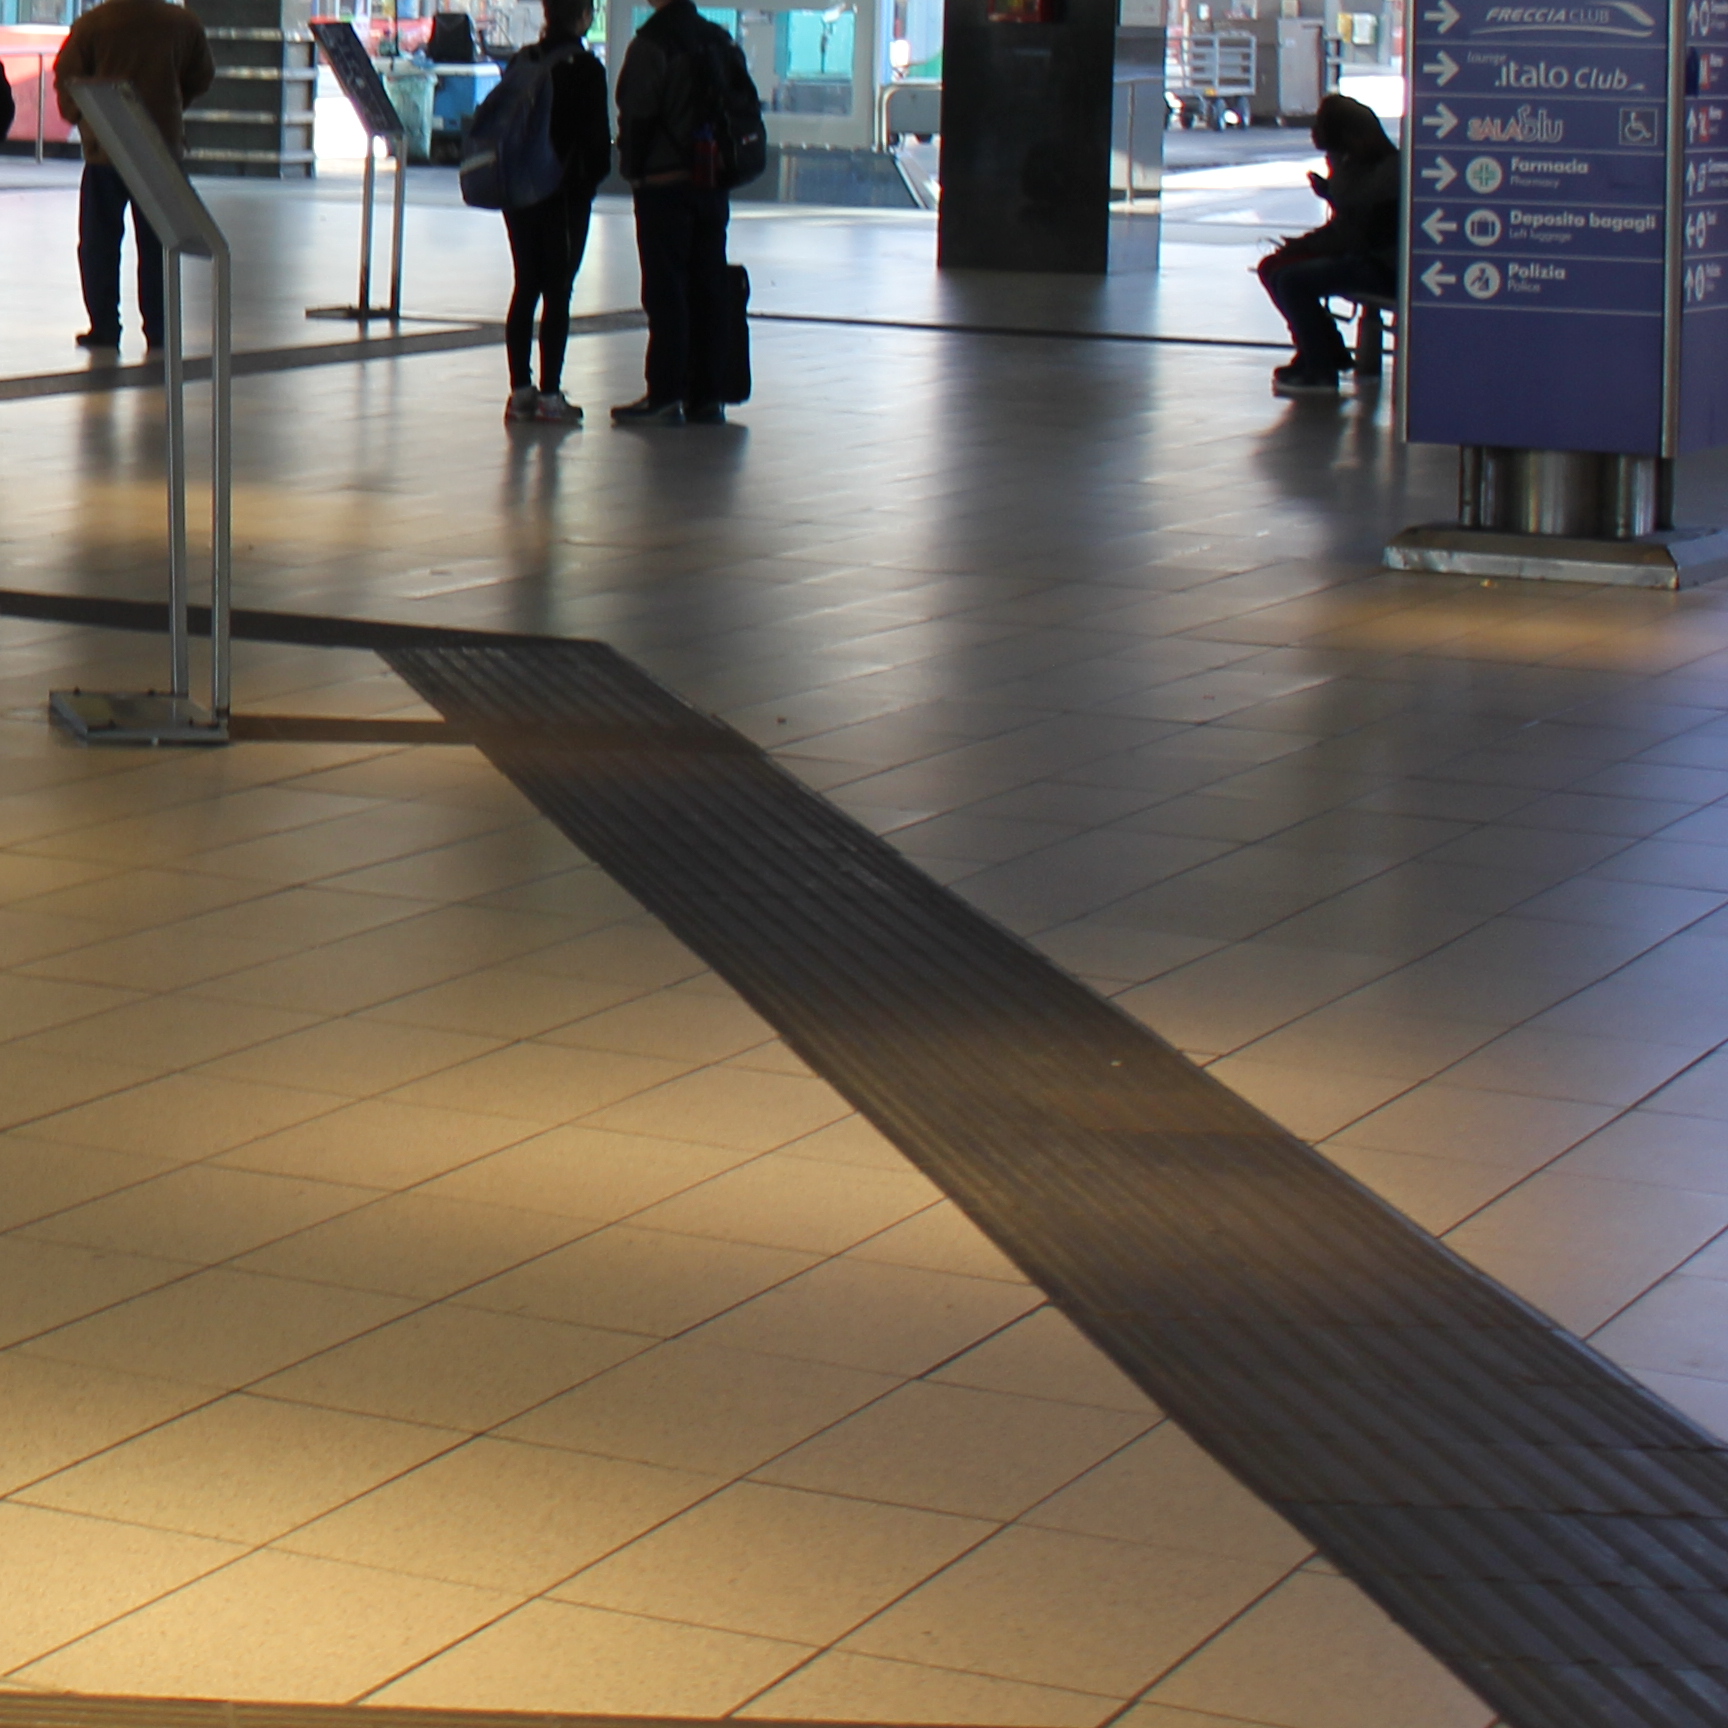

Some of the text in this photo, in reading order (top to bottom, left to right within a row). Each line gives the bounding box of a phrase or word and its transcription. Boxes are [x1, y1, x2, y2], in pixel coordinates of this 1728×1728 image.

[1466, 51, 1507, 66] lounge
[1574, 67, 1628, 90] Club
[1510, 156, 1589, 174] Farmacia
[1510, 175, 1560, 189] Pharmacy
[1510, 209, 1656, 233] Deposito bagagli
[1507, 263, 1566, 281] Polizia
[1507, 280, 1541, 293] Police
